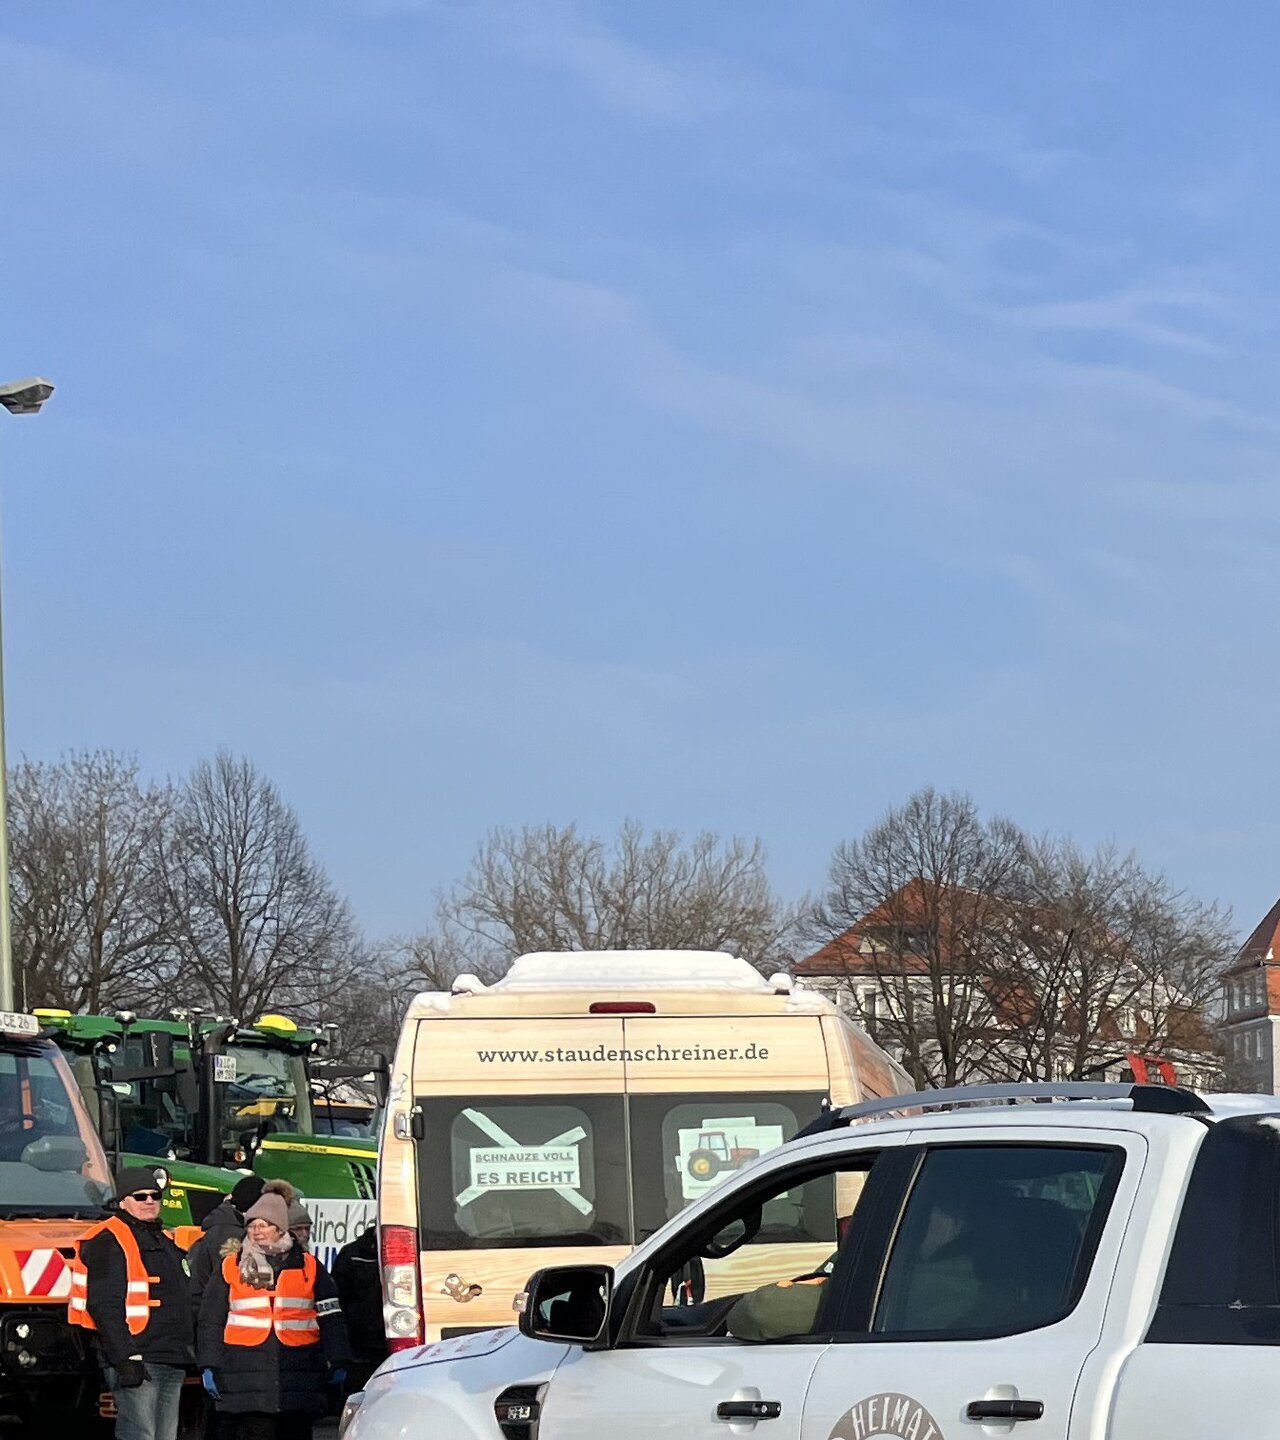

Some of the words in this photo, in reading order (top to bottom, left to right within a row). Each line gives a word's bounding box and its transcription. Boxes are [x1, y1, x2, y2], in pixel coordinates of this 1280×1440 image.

[477, 1044, 769, 1064] www.staudenschreiner.de
[475, 1152, 540, 1163] SCHNAUZE
[543, 1151, 574, 1161] VOLL
[477, 1172, 505, 1185] ES
[509, 1171, 575, 1184] REICHT
